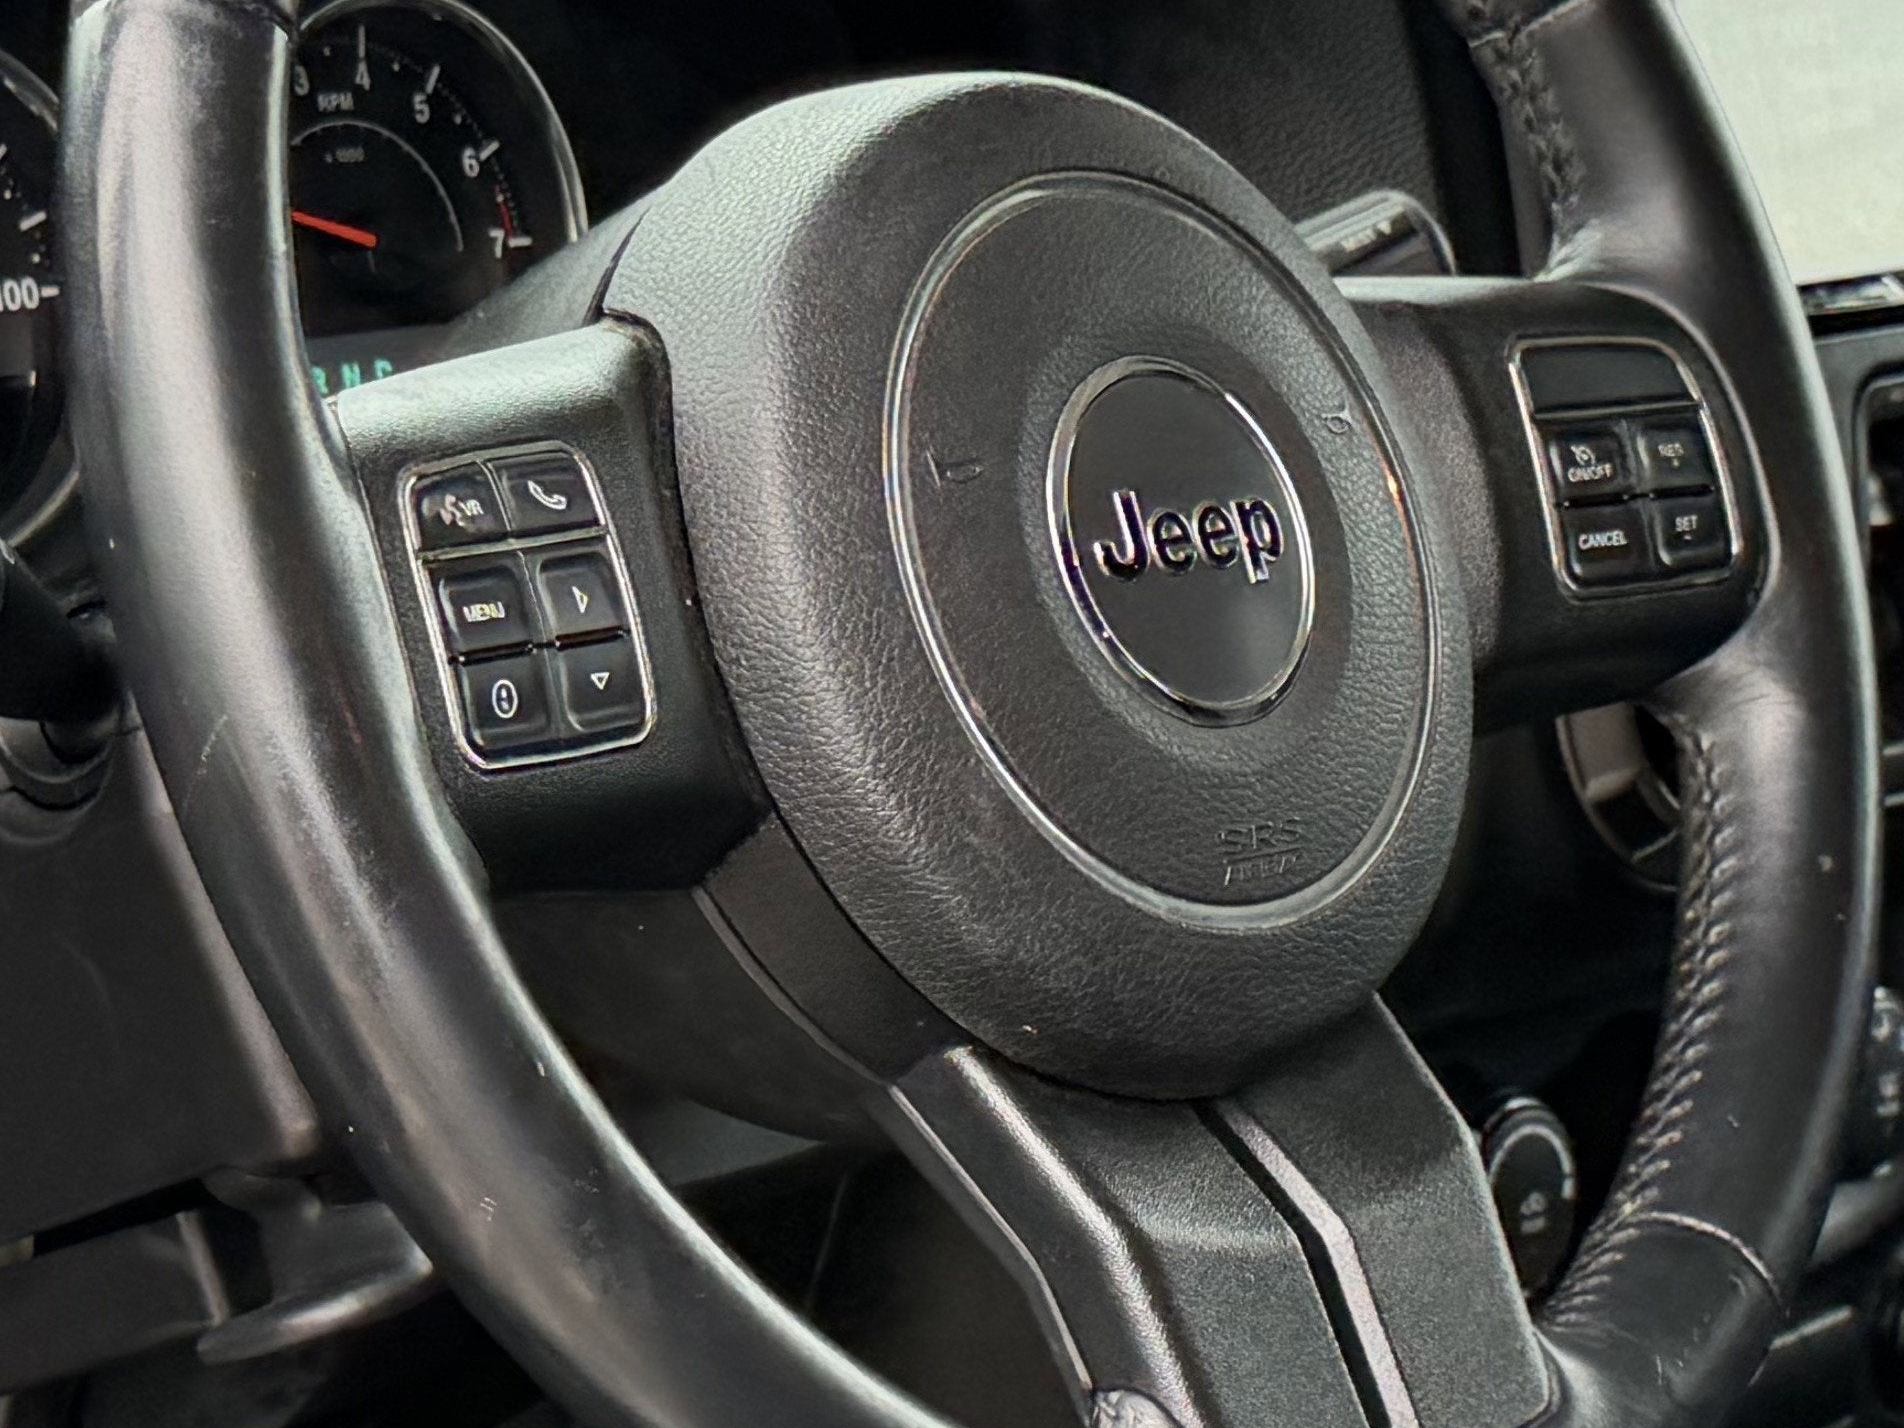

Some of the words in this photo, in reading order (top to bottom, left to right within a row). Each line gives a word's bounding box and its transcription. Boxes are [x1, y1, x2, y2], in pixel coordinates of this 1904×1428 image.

[355, 59, 371, 91] 4
[317, 92, 354, 112] RPM
[412, 92, 430, 123] 5
[462, 147, 480, 177] 6
[488, 228, 504, 258] 7
[458, 499, 484, 516] VR
[1093, 488, 1284, 584] Jeep
[1675, 515, 1698, 532] SET
[1578, 530, 1628, 551] CANCEL
[462, 601, 505, 622] MENU
